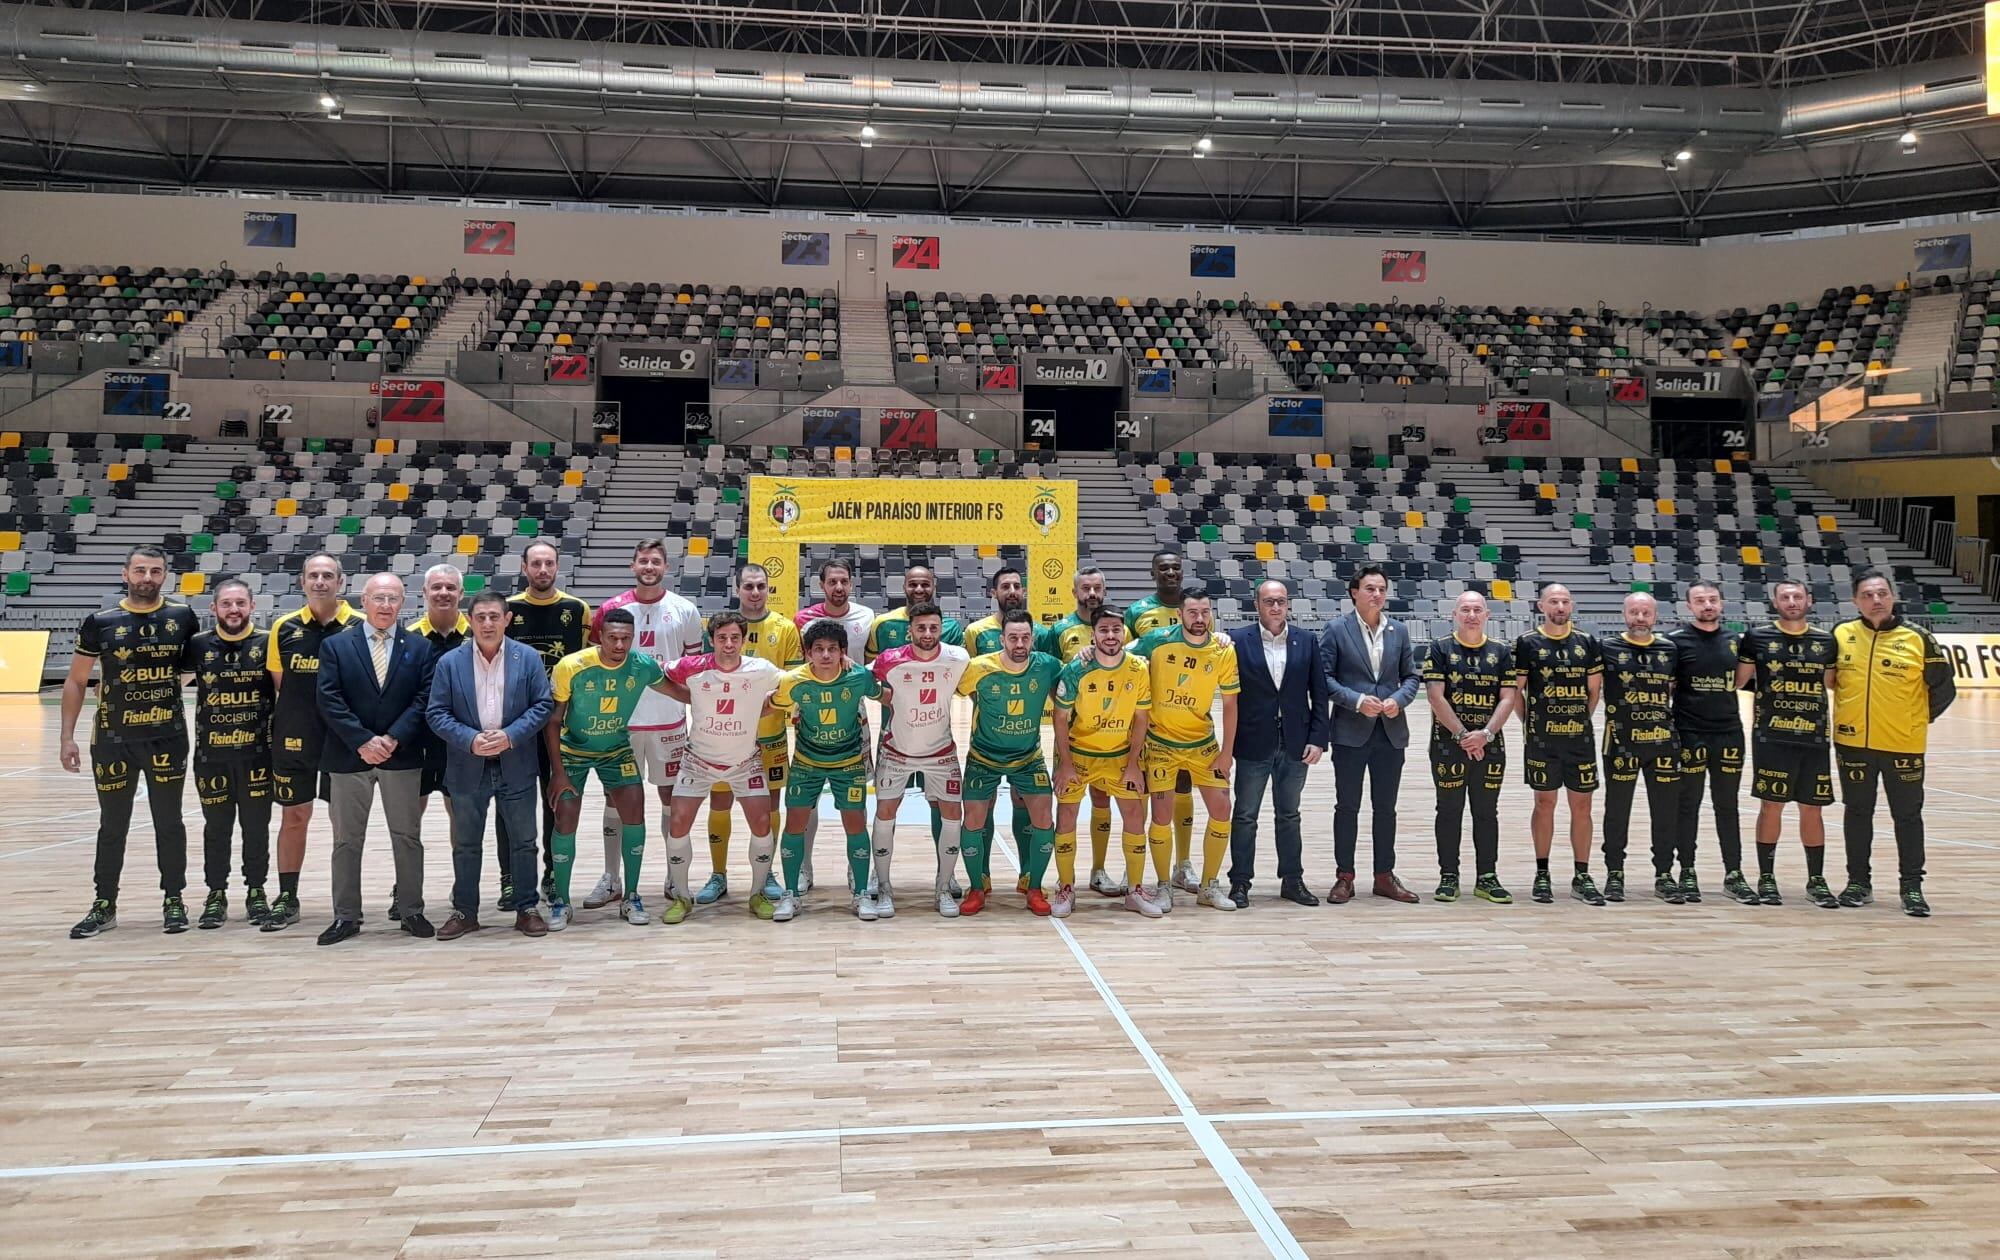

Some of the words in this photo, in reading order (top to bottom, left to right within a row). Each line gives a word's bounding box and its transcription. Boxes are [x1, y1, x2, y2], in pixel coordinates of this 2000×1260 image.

[244, 213, 278, 222] Sector
[464, 220, 497, 230] Sector
[782, 232, 812, 241] Sector
[893, 236, 923, 245] Sector
[1190, 246, 1218, 254] Sector
[1914, 239, 1950, 248] Sector
[893, 237, 939, 269] 24
[1381, 251, 1410, 259] Sector
[619, 356, 671, 370] Salida
[680, 350, 696, 370] 9
[552, 355, 588, 380] 22
[1036, 366, 1084, 380] Salida
[1086, 359, 1107, 379] 10
[105, 373, 147, 384] Sector
[984, 366, 1017, 390] 24
[1656, 379, 1700, 391] Salida
[1703, 372, 1720, 391] 11
[381, 381, 422, 392] Sector
[1614, 378, 1645, 400] 26
[382, 381, 444, 422] 22
[1268, 398, 1303, 408] Sector
[1497, 402, 1531, 412] Sector
[163, 402, 192, 421] 22
[265, 405, 293, 423] 22
[803, 408, 840, 418] Sector
[880, 409, 917, 420] Sector
[880, 409, 937, 449] 24
[1031, 419, 1055, 437] 24
[1117, 421, 1140, 438] 24
[1402, 425, 1425, 442] 25
[1485, 427, 1508, 444] 25
[1723, 430, 1745, 447] 26
[828, 498, 861, 519] JAÉN
[866, 498, 921, 520] PARAÍSO
[925, 502, 983, 521] INTERIOR
[988, 502, 1003, 520] FS
[748, 632, 758, 643] 41
[290, 653, 320, 670] Fisio
[1184, 657, 1196, 669] 20
[137, 664, 173, 681] BULÉ
[922, 671, 934, 683] 29
[605, 679, 617, 691] 12
[723, 682, 731, 693] 8
[1010, 683, 1021, 694] 21
[1108, 681, 1114, 692] 6
[1785, 681, 1822, 695] BULÉ
[220, 690, 260, 705] BULÉ
[820, 691, 832, 703] 10
[1165, 689, 1197, 706] Jaén
[1555, 686, 1586, 698] BULÉ
[1464, 693, 1495, 706] BULÉ
[122, 705, 173, 725] FisioÉlite
[910, 706, 942, 723] Jaén
[588, 715, 623, 730] Jaén
[705, 716, 742, 731] Jaén
[998, 715, 1032, 730] Jaén
[1092, 715, 1124, 728] Jaén
[1546, 719, 1584, 734] FisioÉlite
[1769, 716, 1816, 731] FisioÉlite
[209, 728, 256, 745] FisioÉlite
[814, 725, 847, 740] Jaén
[152, 753, 170, 766] LZ
[1724, 748, 1738, 759] LZ
[668, 763, 678, 773] LZ
[1488, 763, 1501, 775] LZ
[1657, 757, 1672, 768] LZ
[1895, 759, 1910, 769] LZ
[250, 768, 267, 782] LZ
[771, 768, 781, 776] LZ
[1580, 771, 1594, 784] LZ
[750, 777, 761, 785] LZ
[850, 789, 860, 798] LZ
[1816, 784, 1830, 796] LZ
